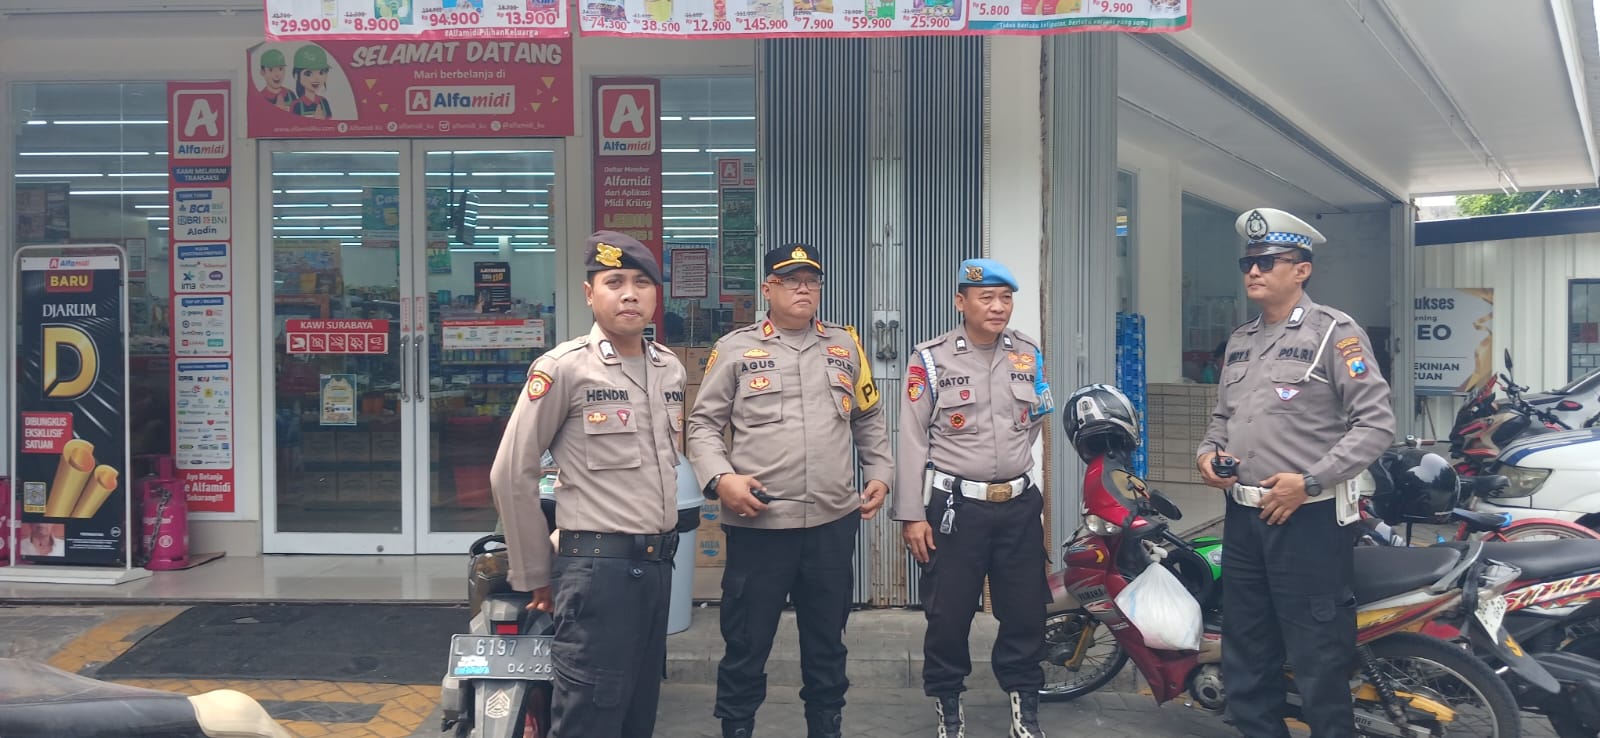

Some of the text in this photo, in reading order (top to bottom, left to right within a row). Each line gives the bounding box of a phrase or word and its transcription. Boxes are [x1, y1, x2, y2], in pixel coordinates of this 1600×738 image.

[979, 4, 1010, 16] 5.800
[1101, 1, 1133, 13] 9.900
[429, 12, 480, 26] 94.900
[505, 11, 556, 25] 13.900
[590, 17, 627, 30] 74.300
[744, 17, 788, 30] 145.900
[802, 17, 833, 29] 7.900
[852, 16, 891, 29] 59.900
[911, 16, 949, 28] 25.900
[280, 18, 331, 32] 29.900
[354, 18, 399, 31] 8.900
[642, 20, 680, 32] 38.500
[693, 20, 731, 31] 12.900
[350, 42, 562, 68] SELAMAT DATANG
[414, 69, 506, 80] Mari berbelanja di
[433, 92, 511, 109] Alfamidi
[178, 144, 225, 155] Alfamidi
[603, 141, 651, 152] Alfamidi
[604, 176, 651, 186] Alfamidi
[189, 204, 210, 213] BCA
[604, 198, 652, 209] Midi Kriing
[50, 275, 88, 287] BARU
[1415, 296, 1455, 310] ukses
[42, 303, 97, 318] DJARUM
[300, 321, 374, 330] KAWI SURABAYA
[1278, 348, 1314, 362] POLRI
[741, 360, 775, 373] AGUS
[1414, 362, 1460, 371] EKINIAN
[939, 376, 971, 388] GATOT
[586, 389, 629, 402] HENDRI
[24, 417, 67, 426] DIBUNGKUS
[25, 428, 64, 438] EKSKLUSIF
[25, 440, 54, 449] SATUAN
[186, 472, 223, 482] Ayo Belanja
[192, 481, 231, 493] Alfamidi
[454, 638, 464, 655] L
[476, 639, 517, 656] 6197
